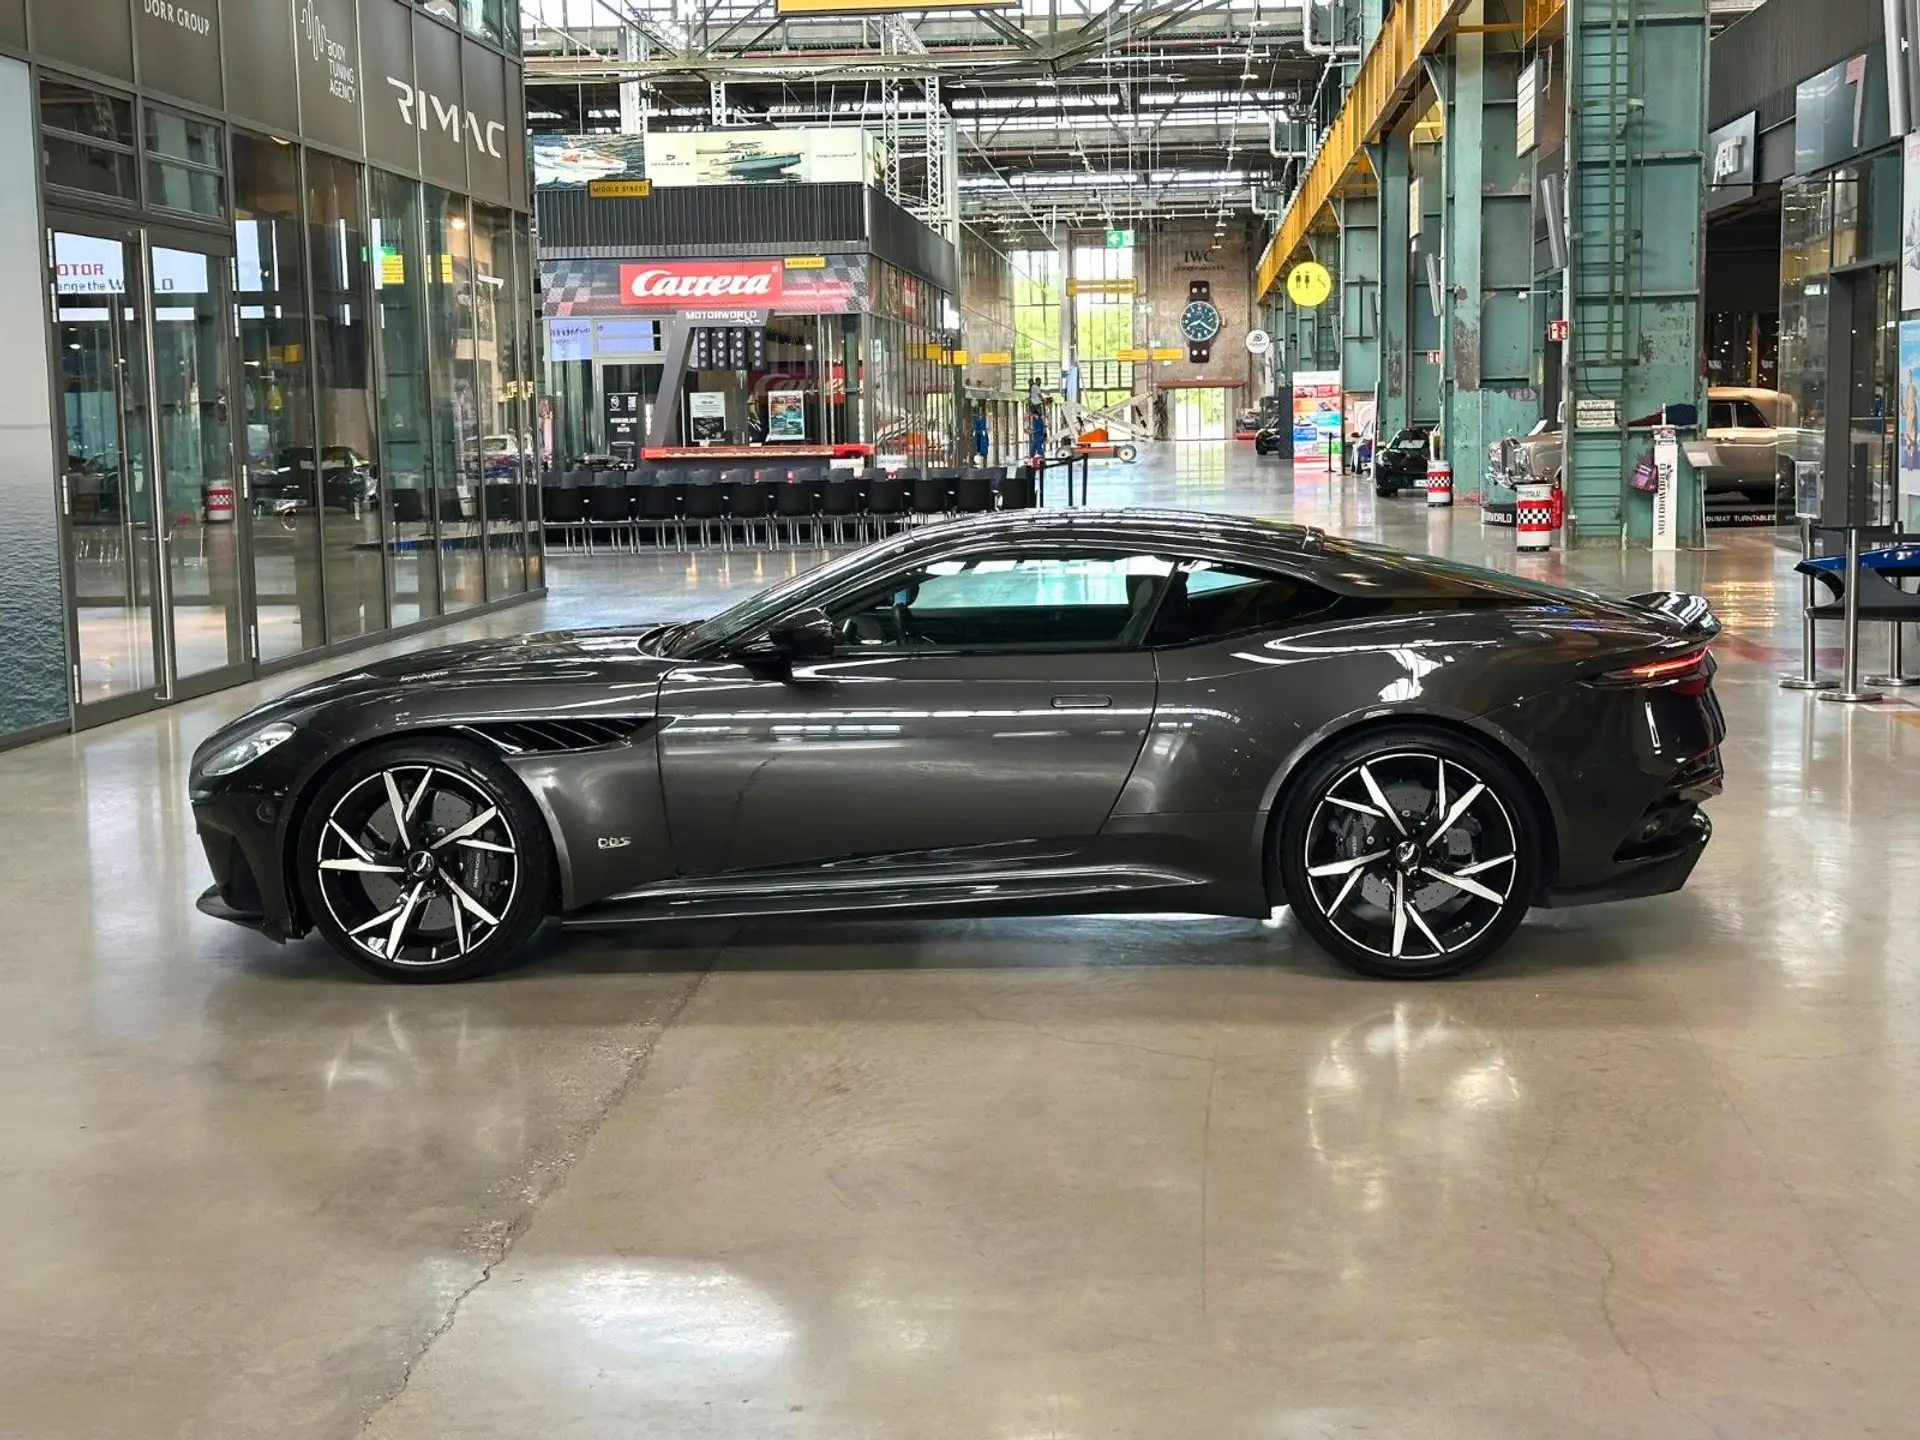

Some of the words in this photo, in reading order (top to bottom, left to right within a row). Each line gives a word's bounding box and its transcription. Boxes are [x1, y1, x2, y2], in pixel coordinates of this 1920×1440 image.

[177, 7, 210, 37] GROUP
[327, 58, 355, 84] TUNING
[329, 78, 357, 103] AGENCY
[386, 76, 505, 159] RIMAC
[1184, 249, 1214, 263] IWC
[56, 263, 105, 276] OTOR
[87, 280, 106, 292] the
[631, 269, 773, 298] Carrera
[685, 310, 758, 320] MOTORWORLD
[1658, 463, 1667, 537] MOTORWORLD
[1734, 514, 1776, 522] TURNTABLES
